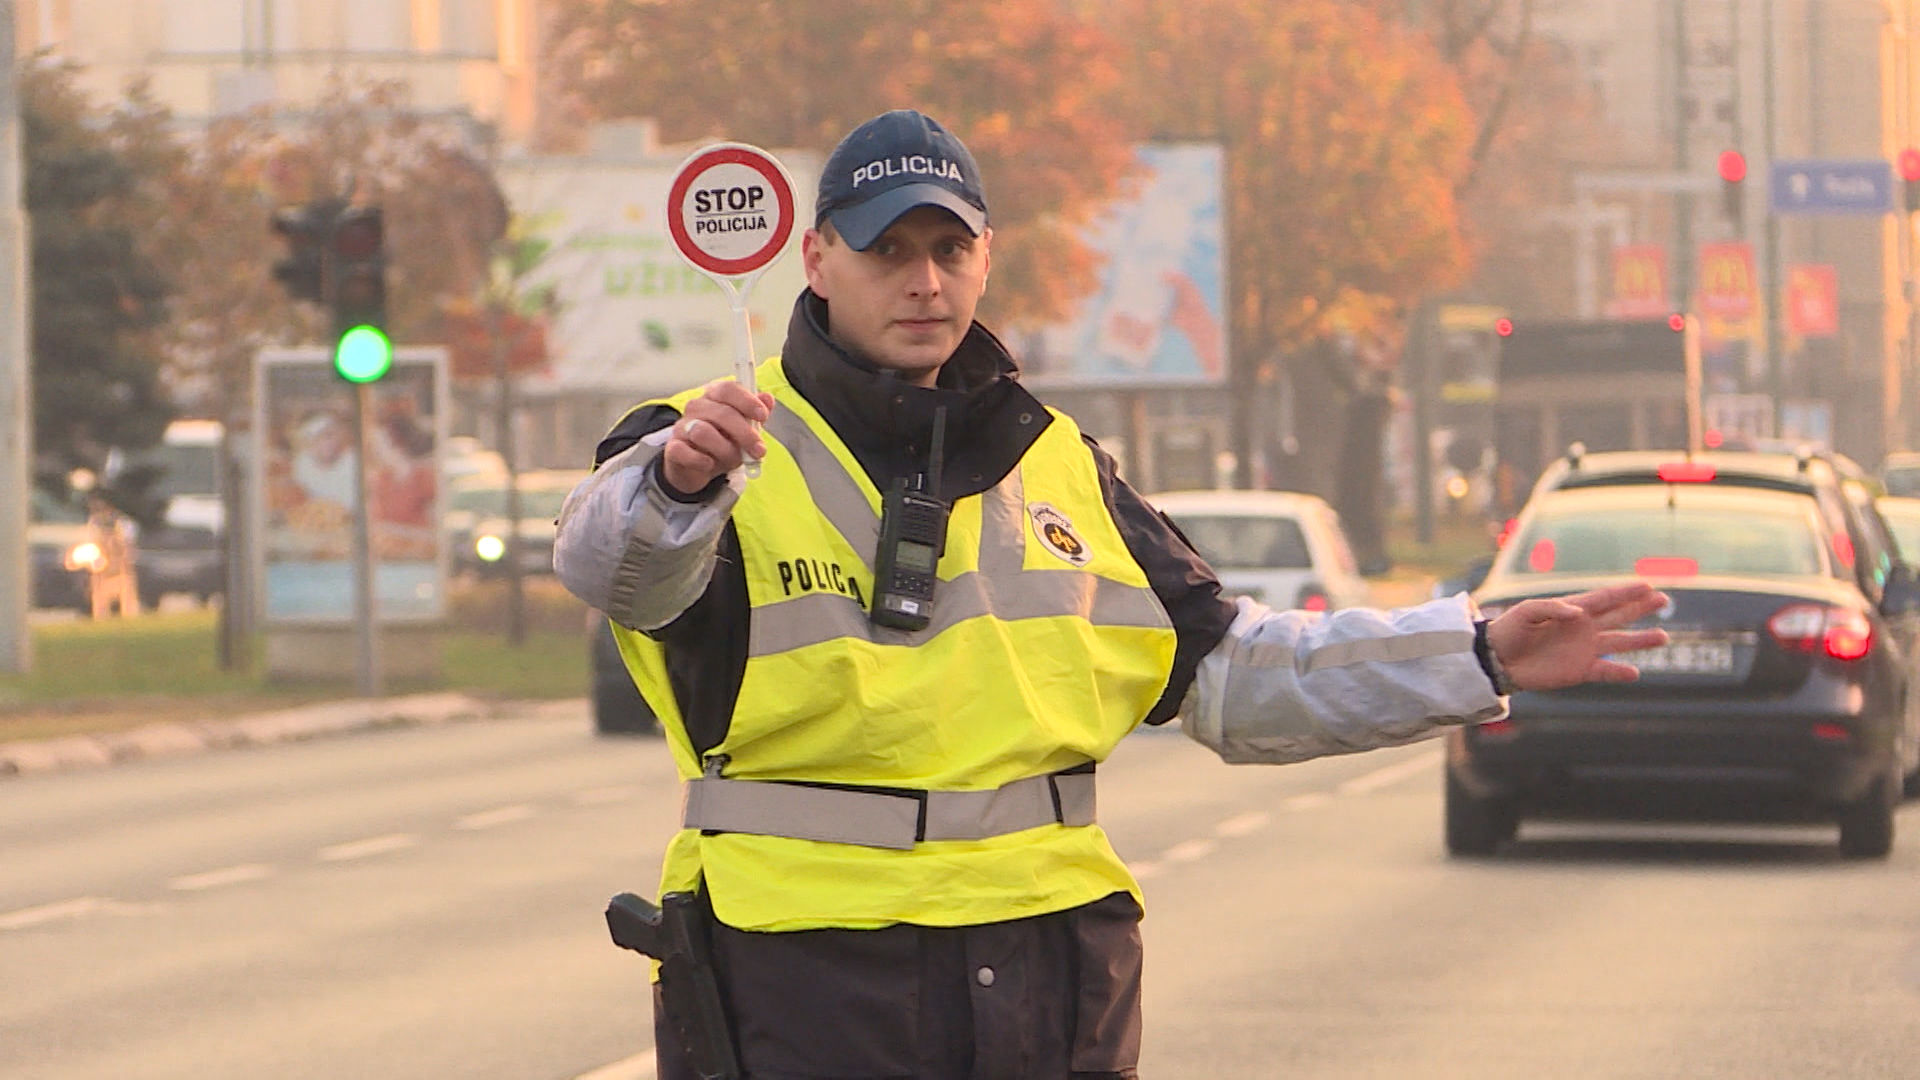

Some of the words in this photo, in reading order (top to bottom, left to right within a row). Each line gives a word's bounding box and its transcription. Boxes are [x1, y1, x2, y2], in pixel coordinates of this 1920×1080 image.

[853, 155, 964, 188] POLICIJA
[695, 185, 764, 213] STOP
[696, 215, 767, 234] POLICIJA
